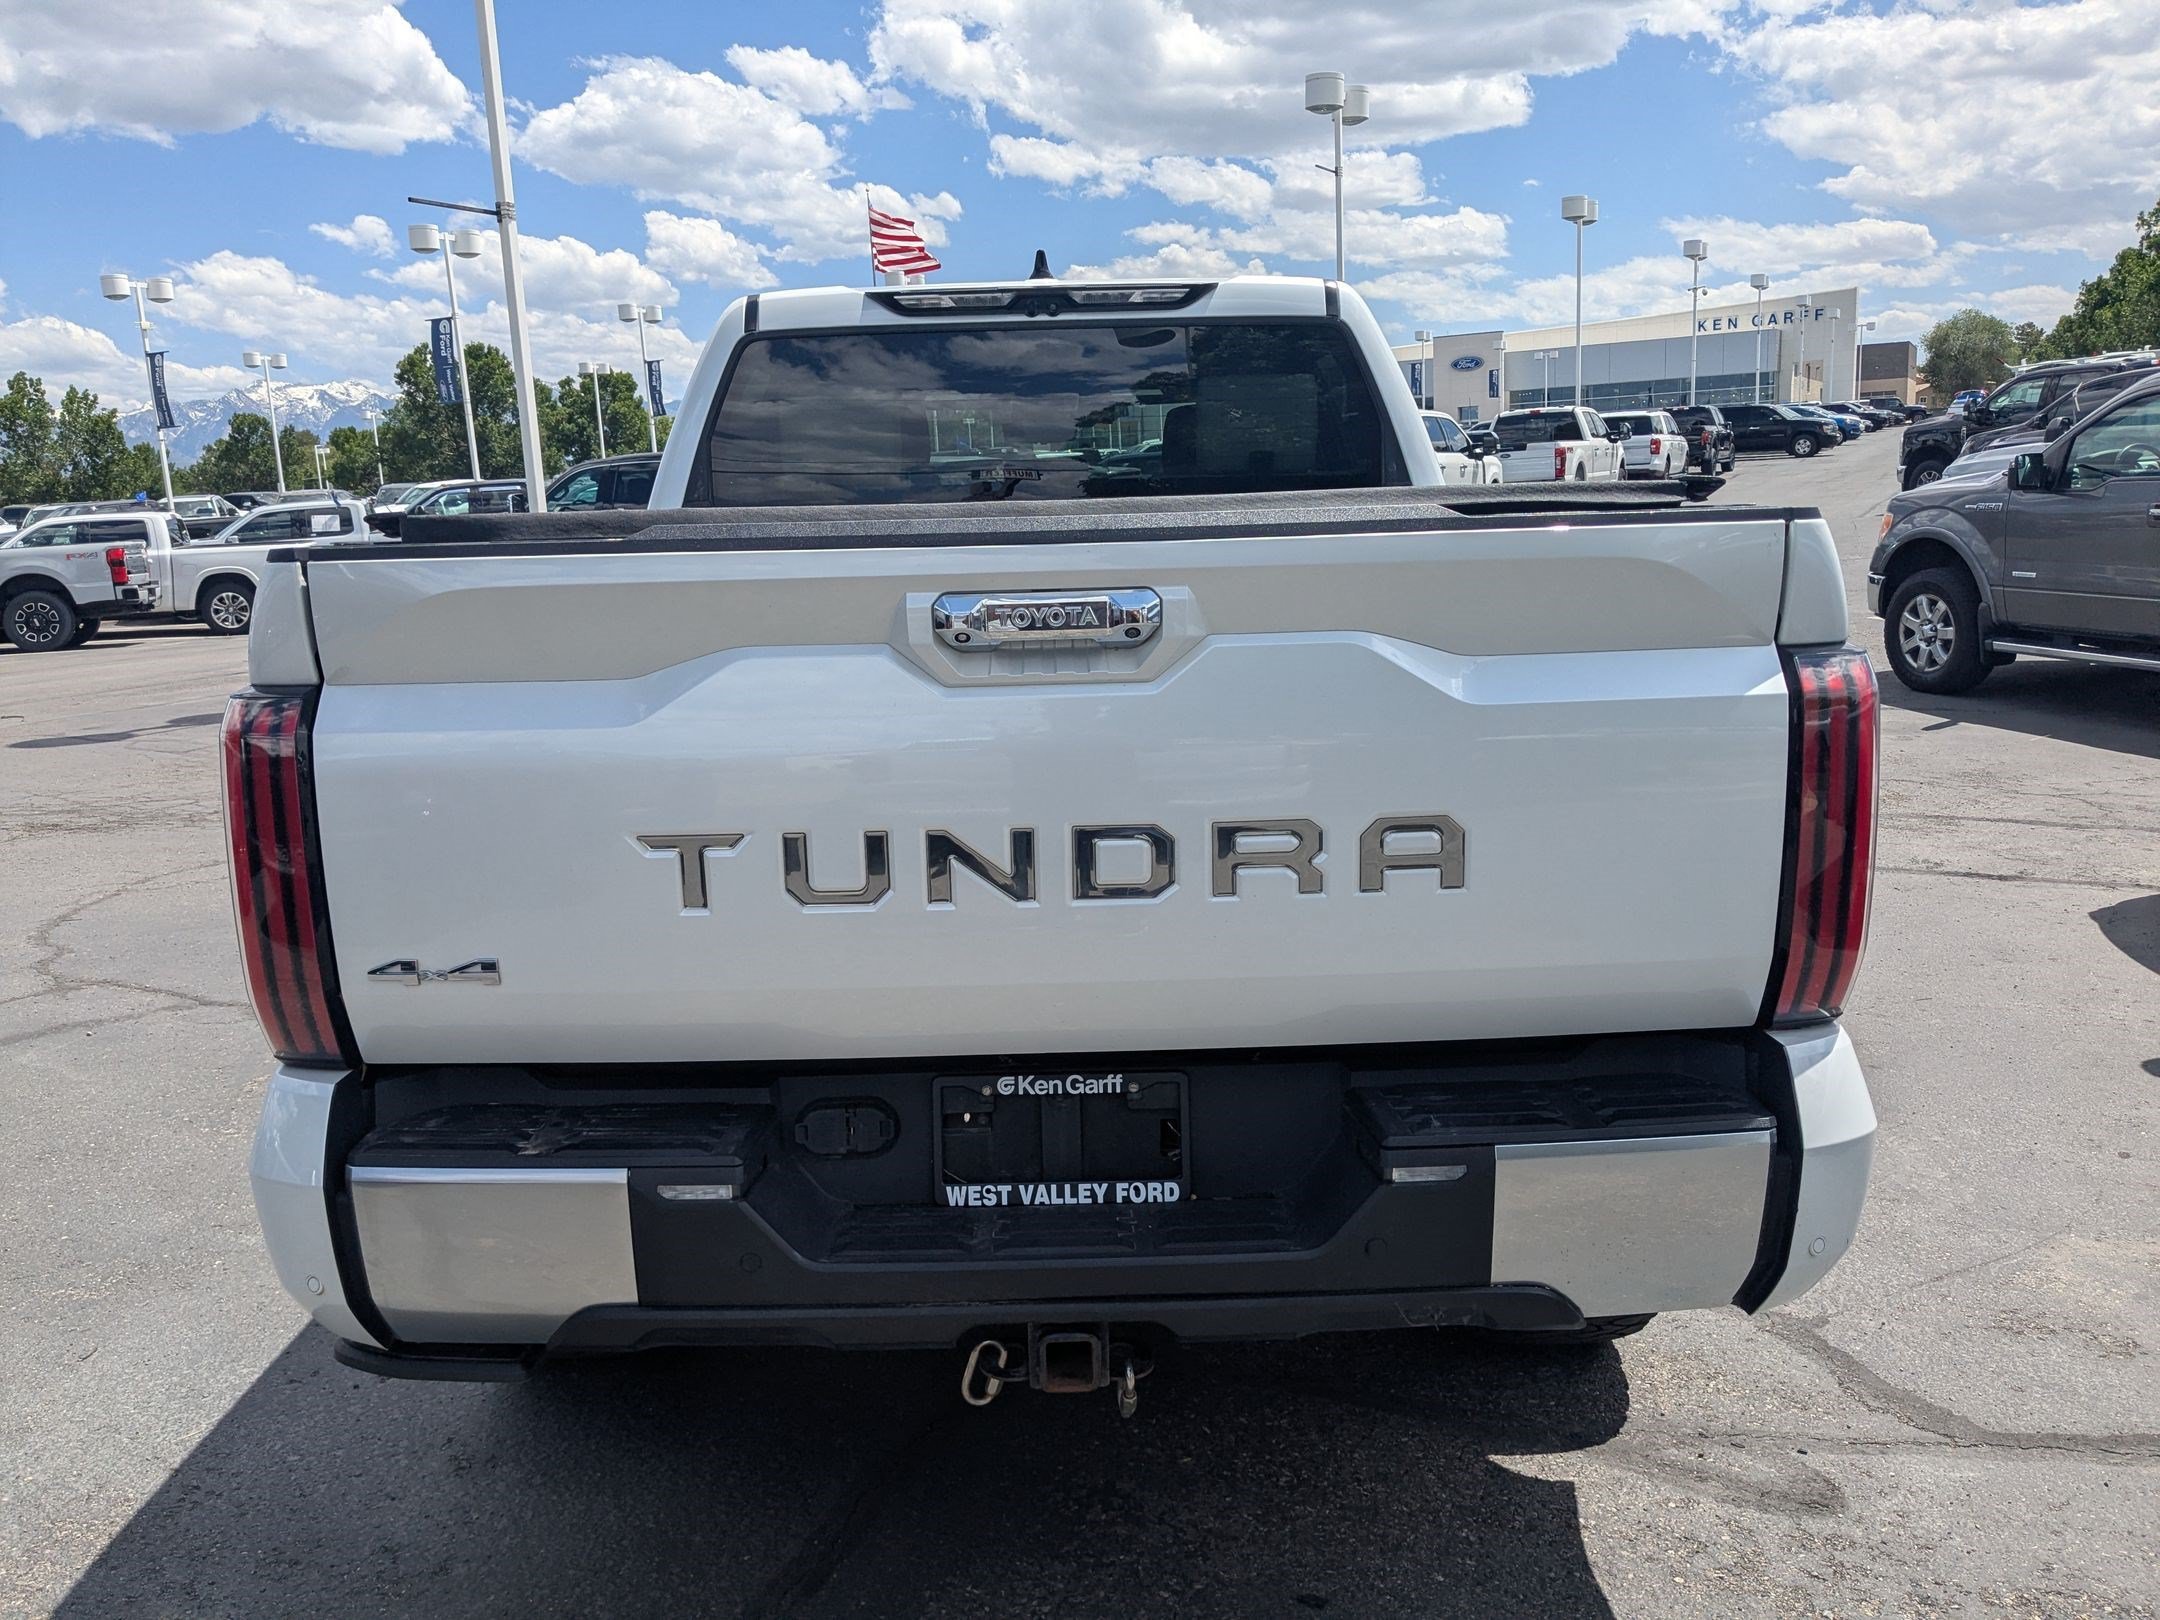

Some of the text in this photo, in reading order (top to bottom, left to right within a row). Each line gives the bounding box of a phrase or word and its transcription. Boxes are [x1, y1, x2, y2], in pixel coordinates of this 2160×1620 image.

[1698, 308, 1825, 332] KEN GARFF
[439, 335, 447, 357] Ford
[995, 604, 1100, 628] TOYOTA
[633, 815, 1467, 913] TUNDRA
[1018, 1073, 1123, 1095] Ken Garff
[945, 1181, 1180, 1206] WEST VALLEY FORD
